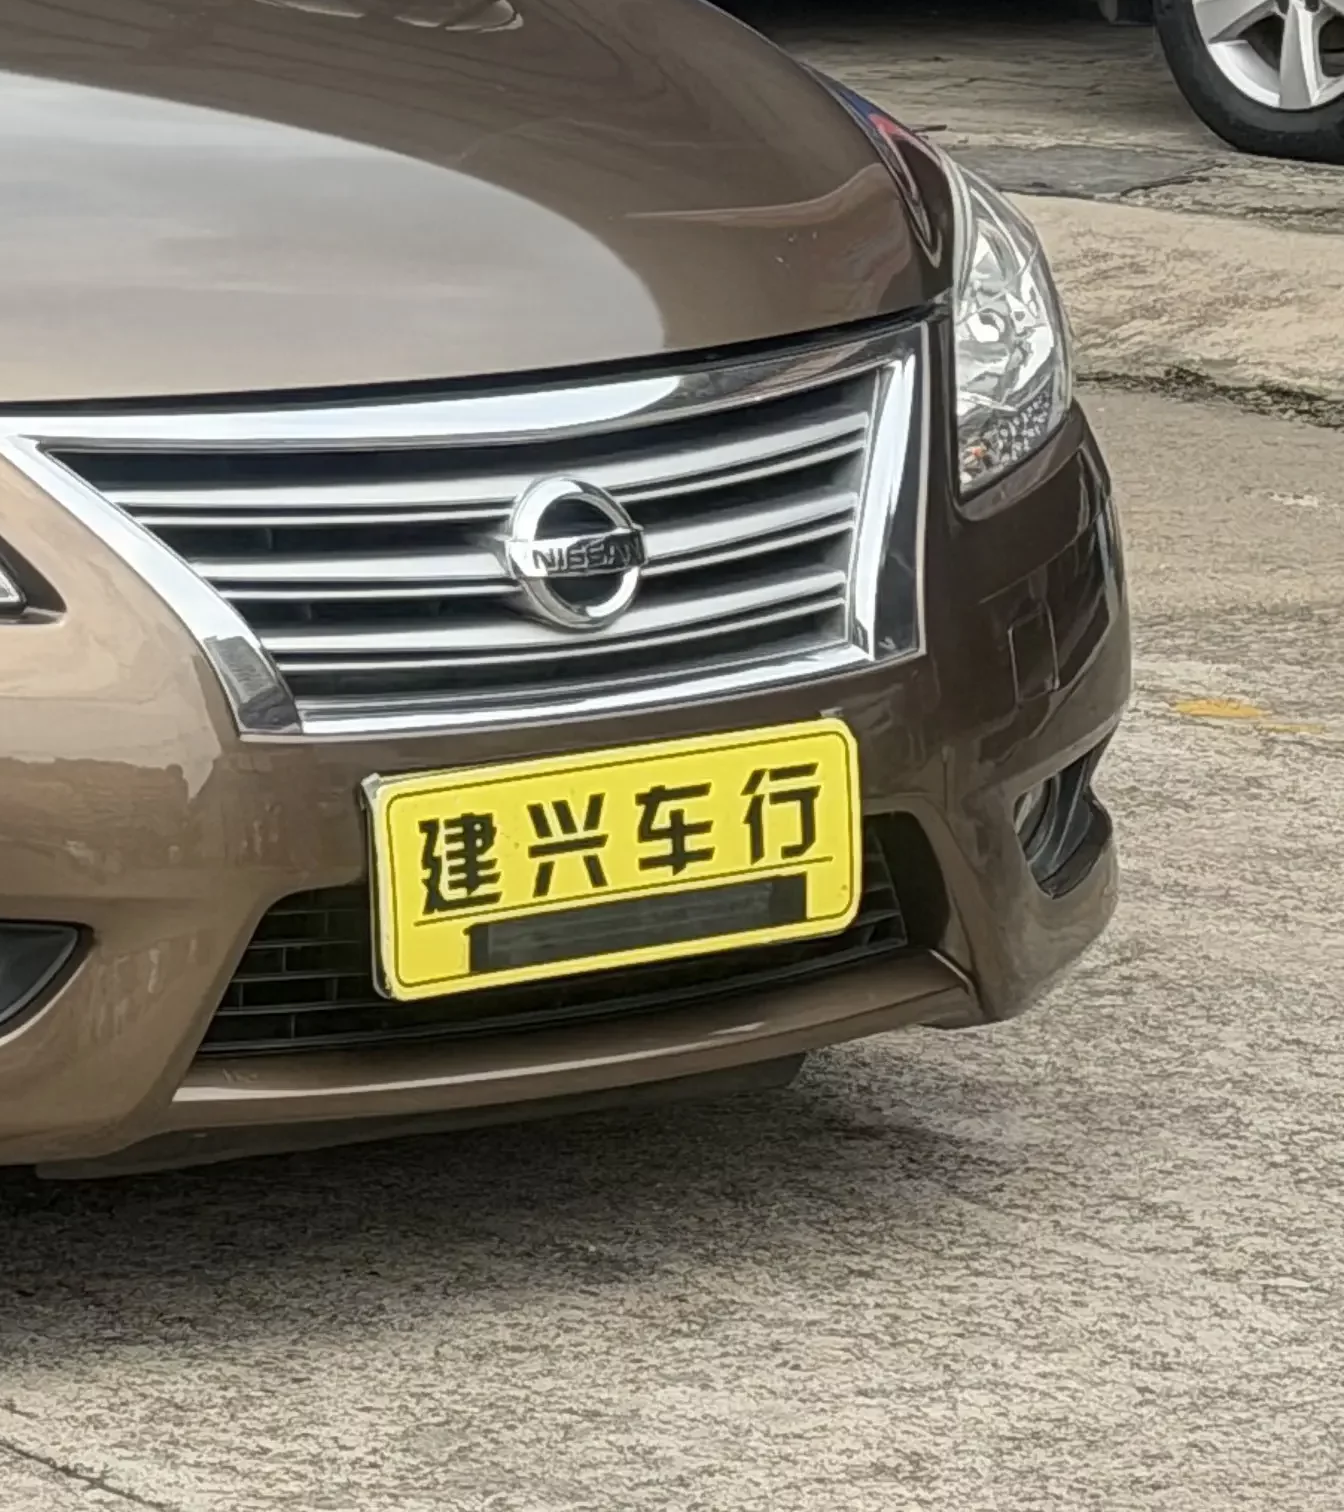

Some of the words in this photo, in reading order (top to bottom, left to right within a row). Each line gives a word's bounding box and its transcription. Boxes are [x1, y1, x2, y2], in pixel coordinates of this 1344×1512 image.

[531, 533, 643, 571] NISSAN
[418, 762, 822, 915] 建兴车行
